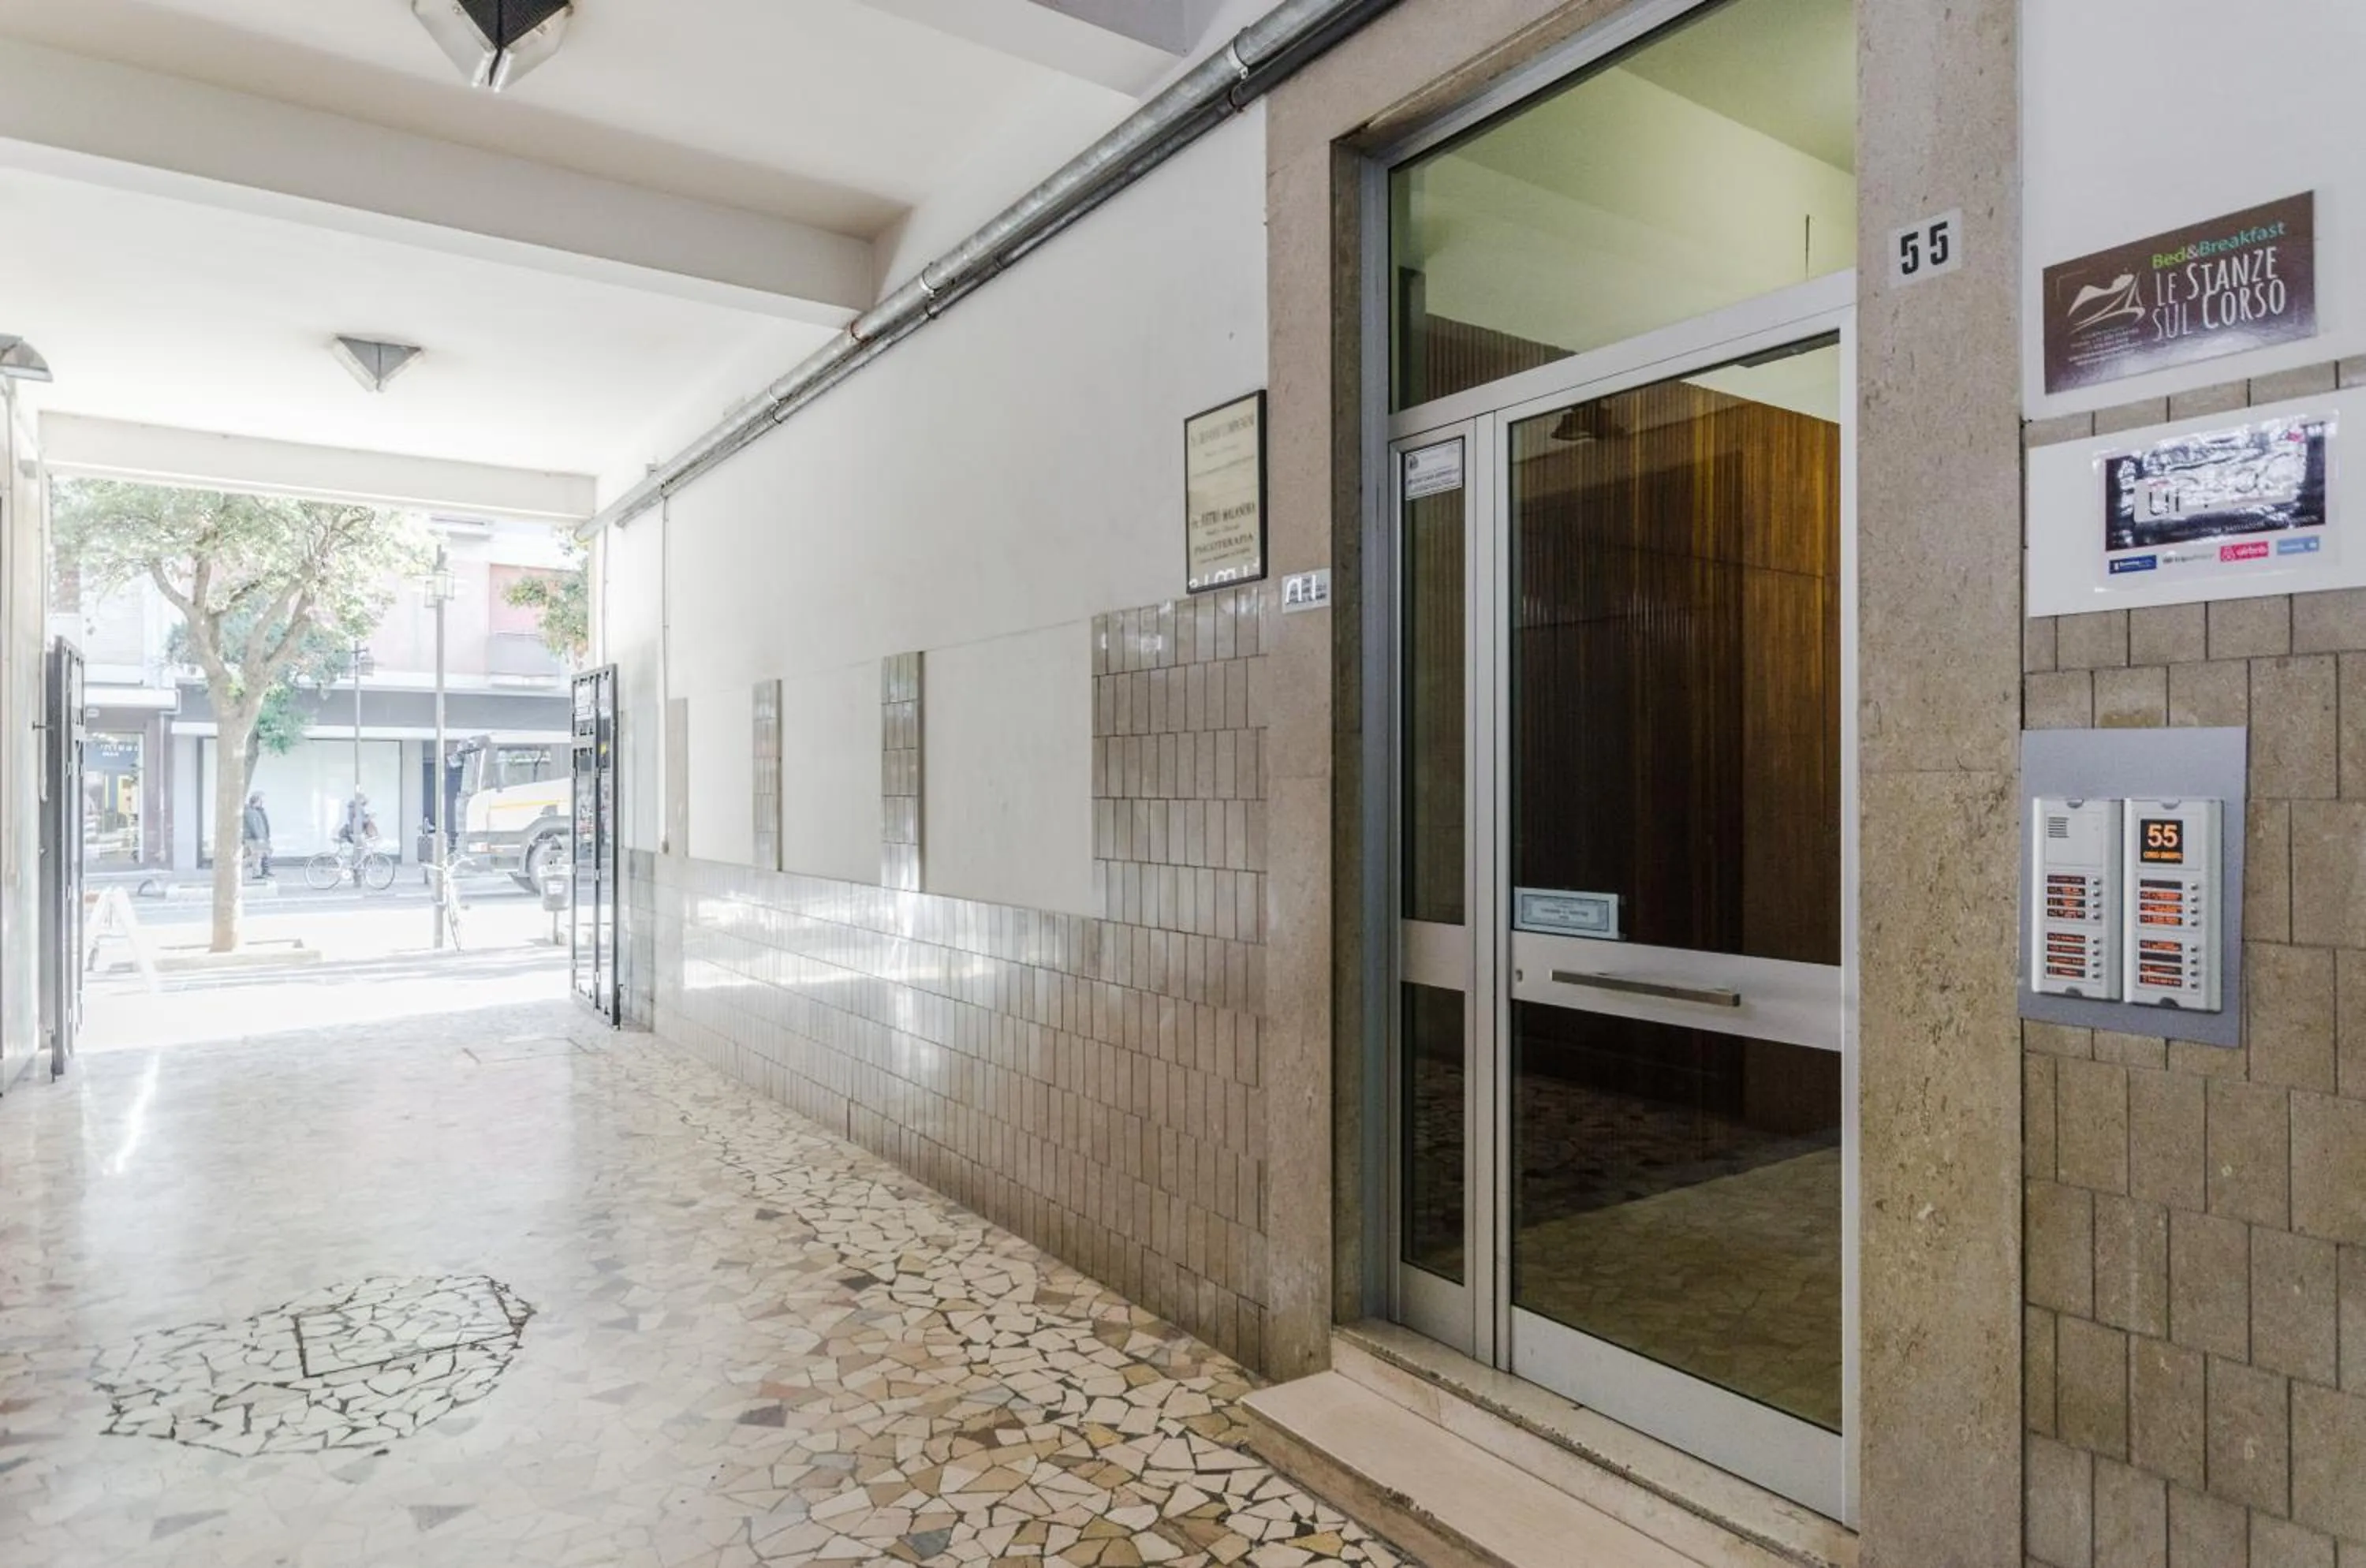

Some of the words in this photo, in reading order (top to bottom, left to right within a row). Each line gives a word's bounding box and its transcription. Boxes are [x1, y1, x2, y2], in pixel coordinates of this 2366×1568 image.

[1901, 221, 1948, 274] 55
[2151, 221, 2286, 270] Bed&Breakfast
[2155, 271, 2178, 307] LE
[2186, 245, 2278, 301] STANZE
[2151, 302, 2193, 342] SUL
[2202, 279, 2286, 330] CORSO
[2148, 823, 2178, 848] 55
